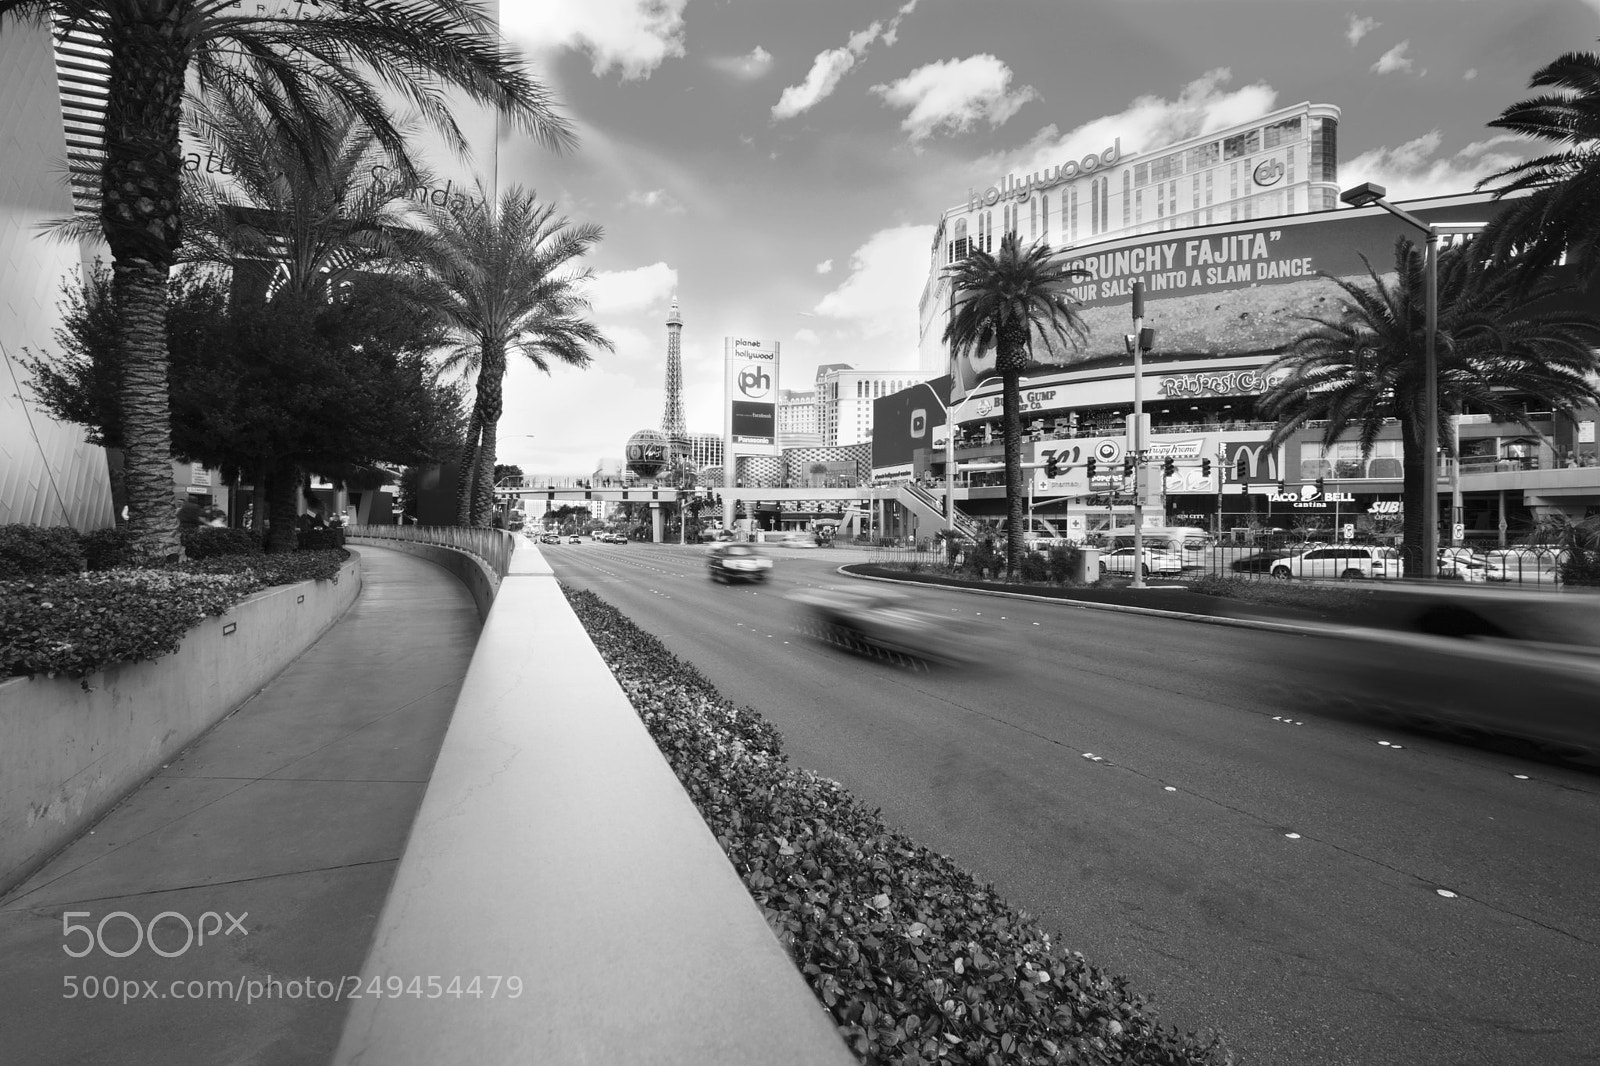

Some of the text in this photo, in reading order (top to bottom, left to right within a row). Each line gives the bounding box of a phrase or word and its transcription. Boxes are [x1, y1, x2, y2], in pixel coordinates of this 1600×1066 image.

[968, 136, 1120, 212] hollywood
[1151, 270, 1187, 291] INTO
[1191, 269, 1202, 286] A
[1206, 263, 1251, 285] SLAM
[1256, 257, 1317, 280] DANCE.
[735, 338, 761, 348] planet
[735, 349, 774, 360] hollywood
[1163, 373, 1236, 397] Rainforest
[1027, 390, 1057, 403] GUMP
[1265, 493, 1356, 502] TACO BELL
